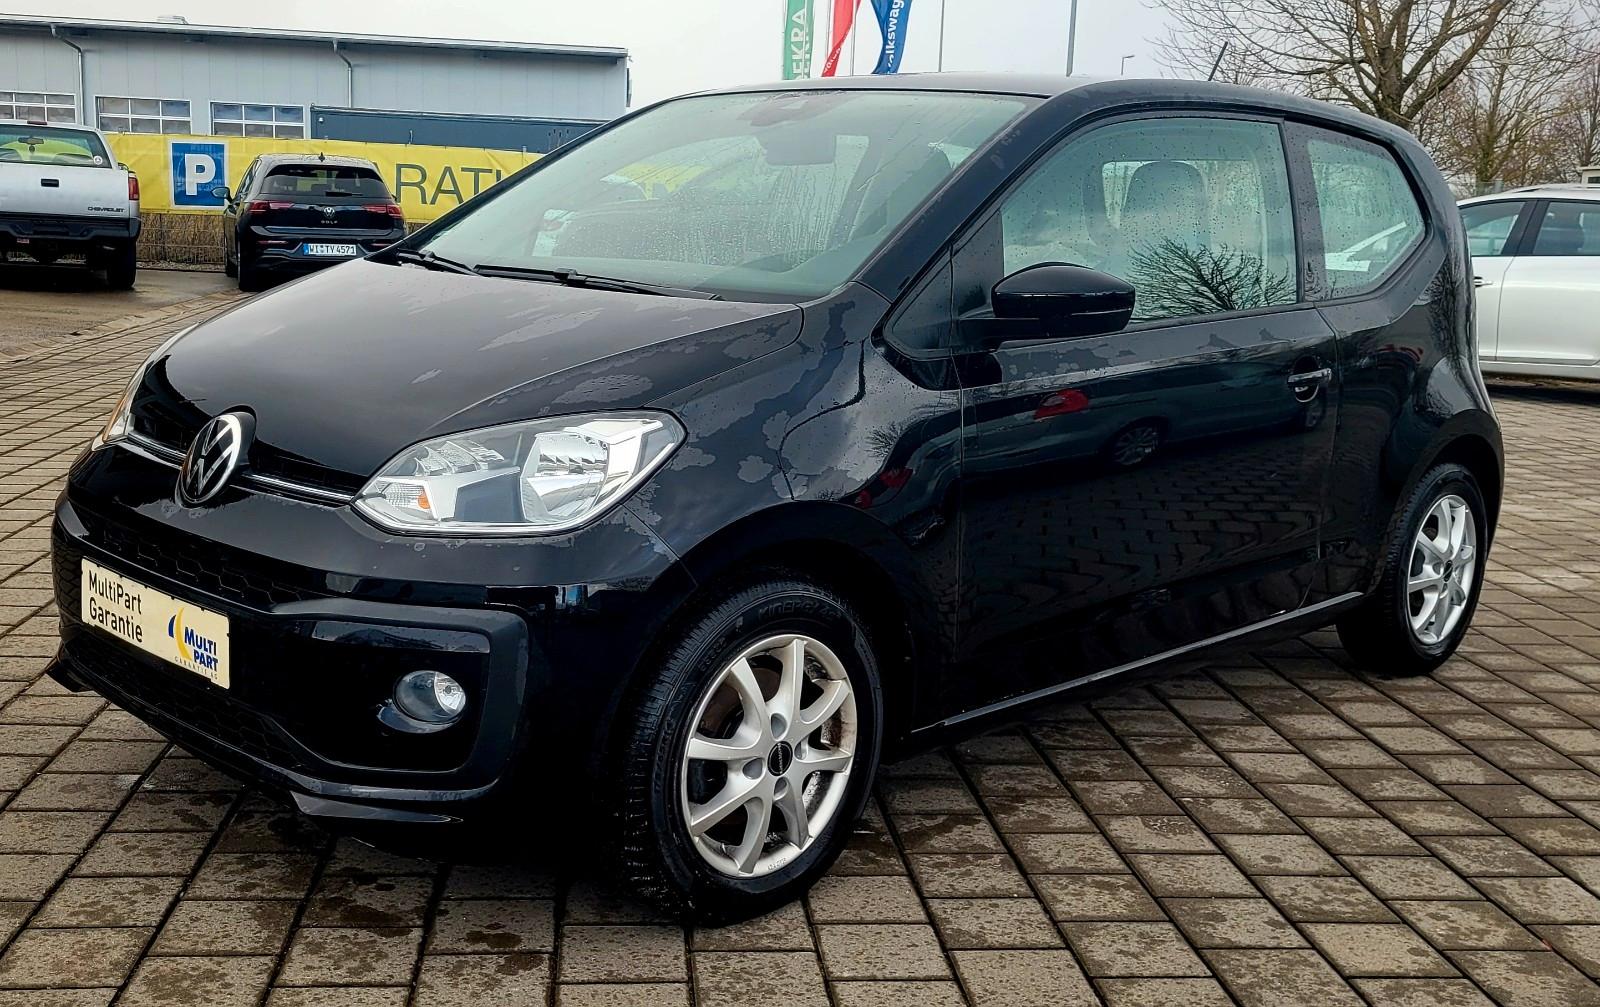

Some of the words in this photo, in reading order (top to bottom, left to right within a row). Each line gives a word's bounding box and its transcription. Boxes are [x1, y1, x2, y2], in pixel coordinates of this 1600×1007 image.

[185, 154, 216, 196] P
[373, 161, 502, 206] RAT
[88, 569, 142, 615] MultiPart
[88, 596, 143, 643] Garantie
[184, 626, 217, 656] MULTI
[193, 648, 219, 672] PART
